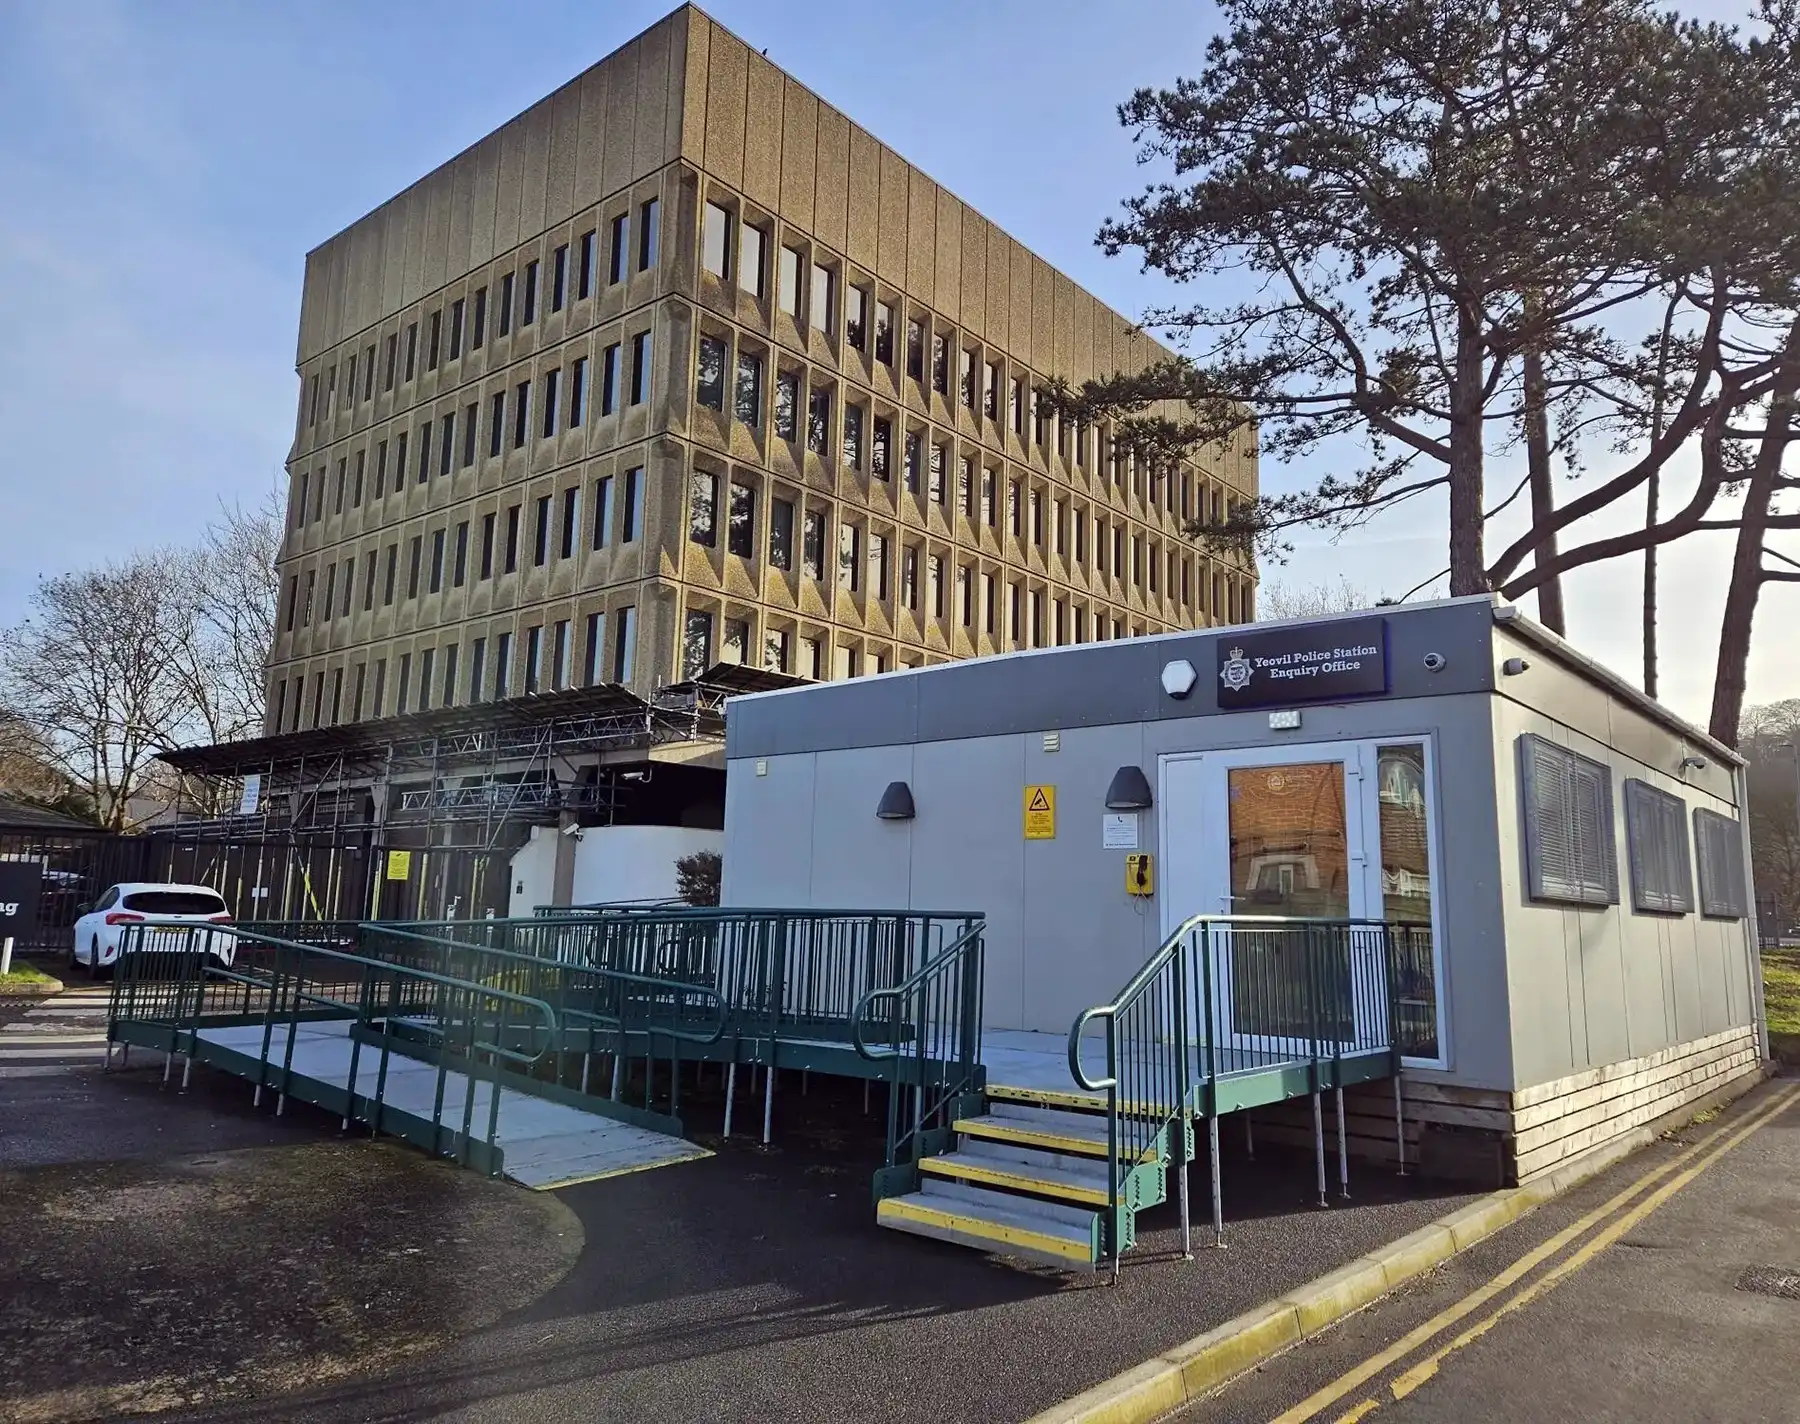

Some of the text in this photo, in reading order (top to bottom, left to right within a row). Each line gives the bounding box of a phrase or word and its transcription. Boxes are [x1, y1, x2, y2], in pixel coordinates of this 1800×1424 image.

[1255, 646, 1377, 667] Yeovil Police Station
[1270, 661, 1361, 678] Enquiry Office
